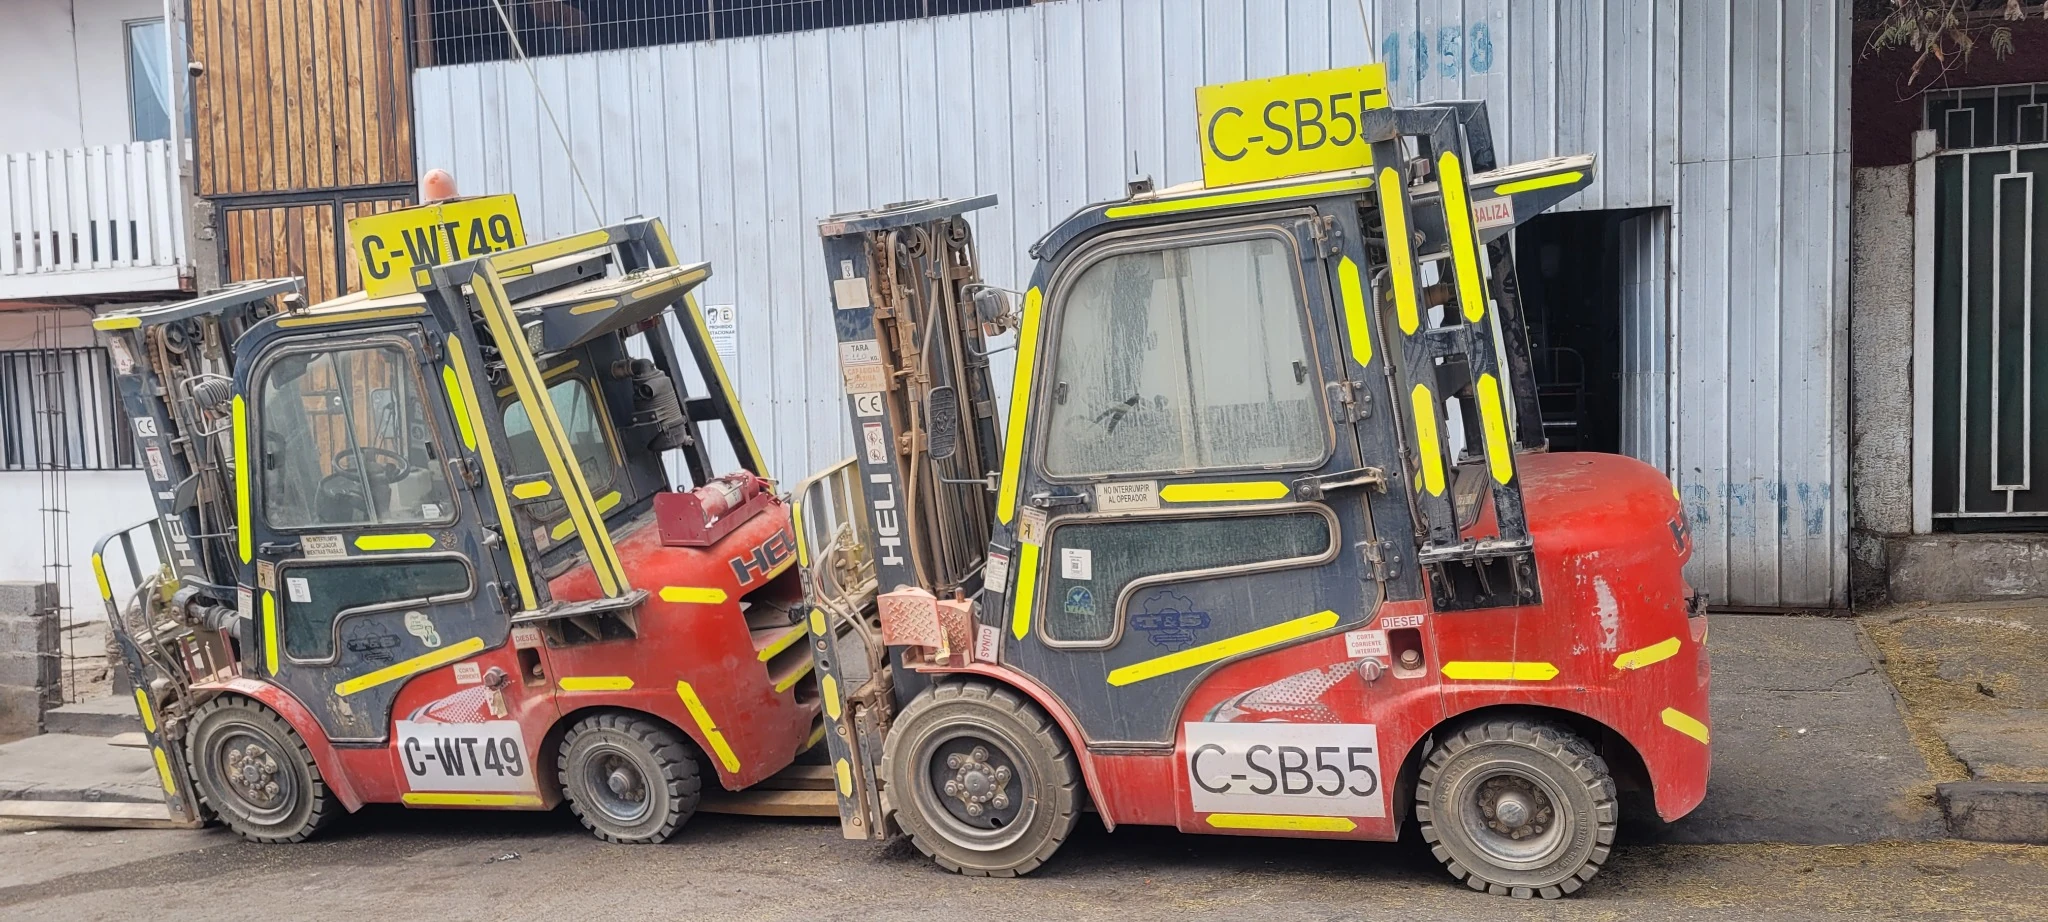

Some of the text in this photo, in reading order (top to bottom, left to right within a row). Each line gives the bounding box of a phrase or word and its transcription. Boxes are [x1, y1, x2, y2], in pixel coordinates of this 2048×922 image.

[361, 213, 516, 280] C-WT49
[858, 395, 881, 413] CE
[138, 419, 156, 435] CE
[1103, 484, 1150, 494] NO INTERRUMPIR
[1108, 494, 1148, 503] AL OPERADOR
[870, 473, 904, 566] HELI
[1382, 616, 1423, 628] DIESEL
[980, 628, 993, 659] CUÑAS
[1351, 640, 1382, 648] CORRIENTE
[1355, 647, 1381, 655] INTERIOR
[404, 736, 524, 776] C-WT49
[1191, 743, 1378, 797] C-SB55
